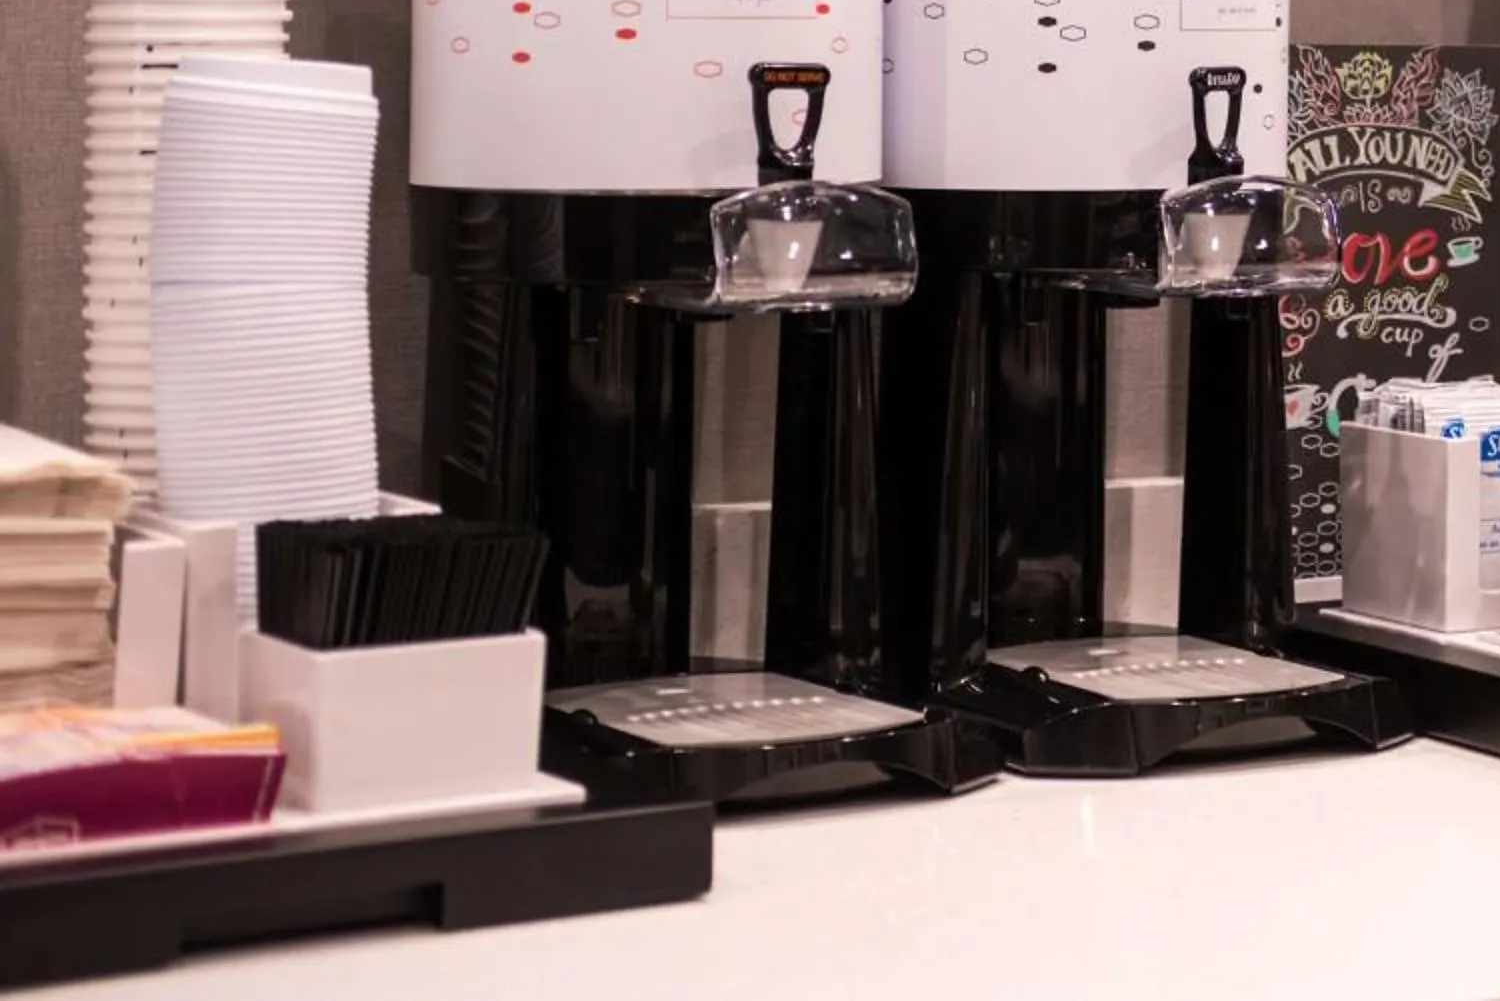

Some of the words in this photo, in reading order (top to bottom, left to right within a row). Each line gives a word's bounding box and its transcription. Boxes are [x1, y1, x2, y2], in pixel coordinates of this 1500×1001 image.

[1289, 134, 1343, 183] ALL
[1348, 127, 1405, 165] YOU
[1327, 289, 1355, 319] a
[1362, 276, 1450, 337] good
[1380, 326, 1424, 357] cup
[1427, 333, 1463, 383] of
